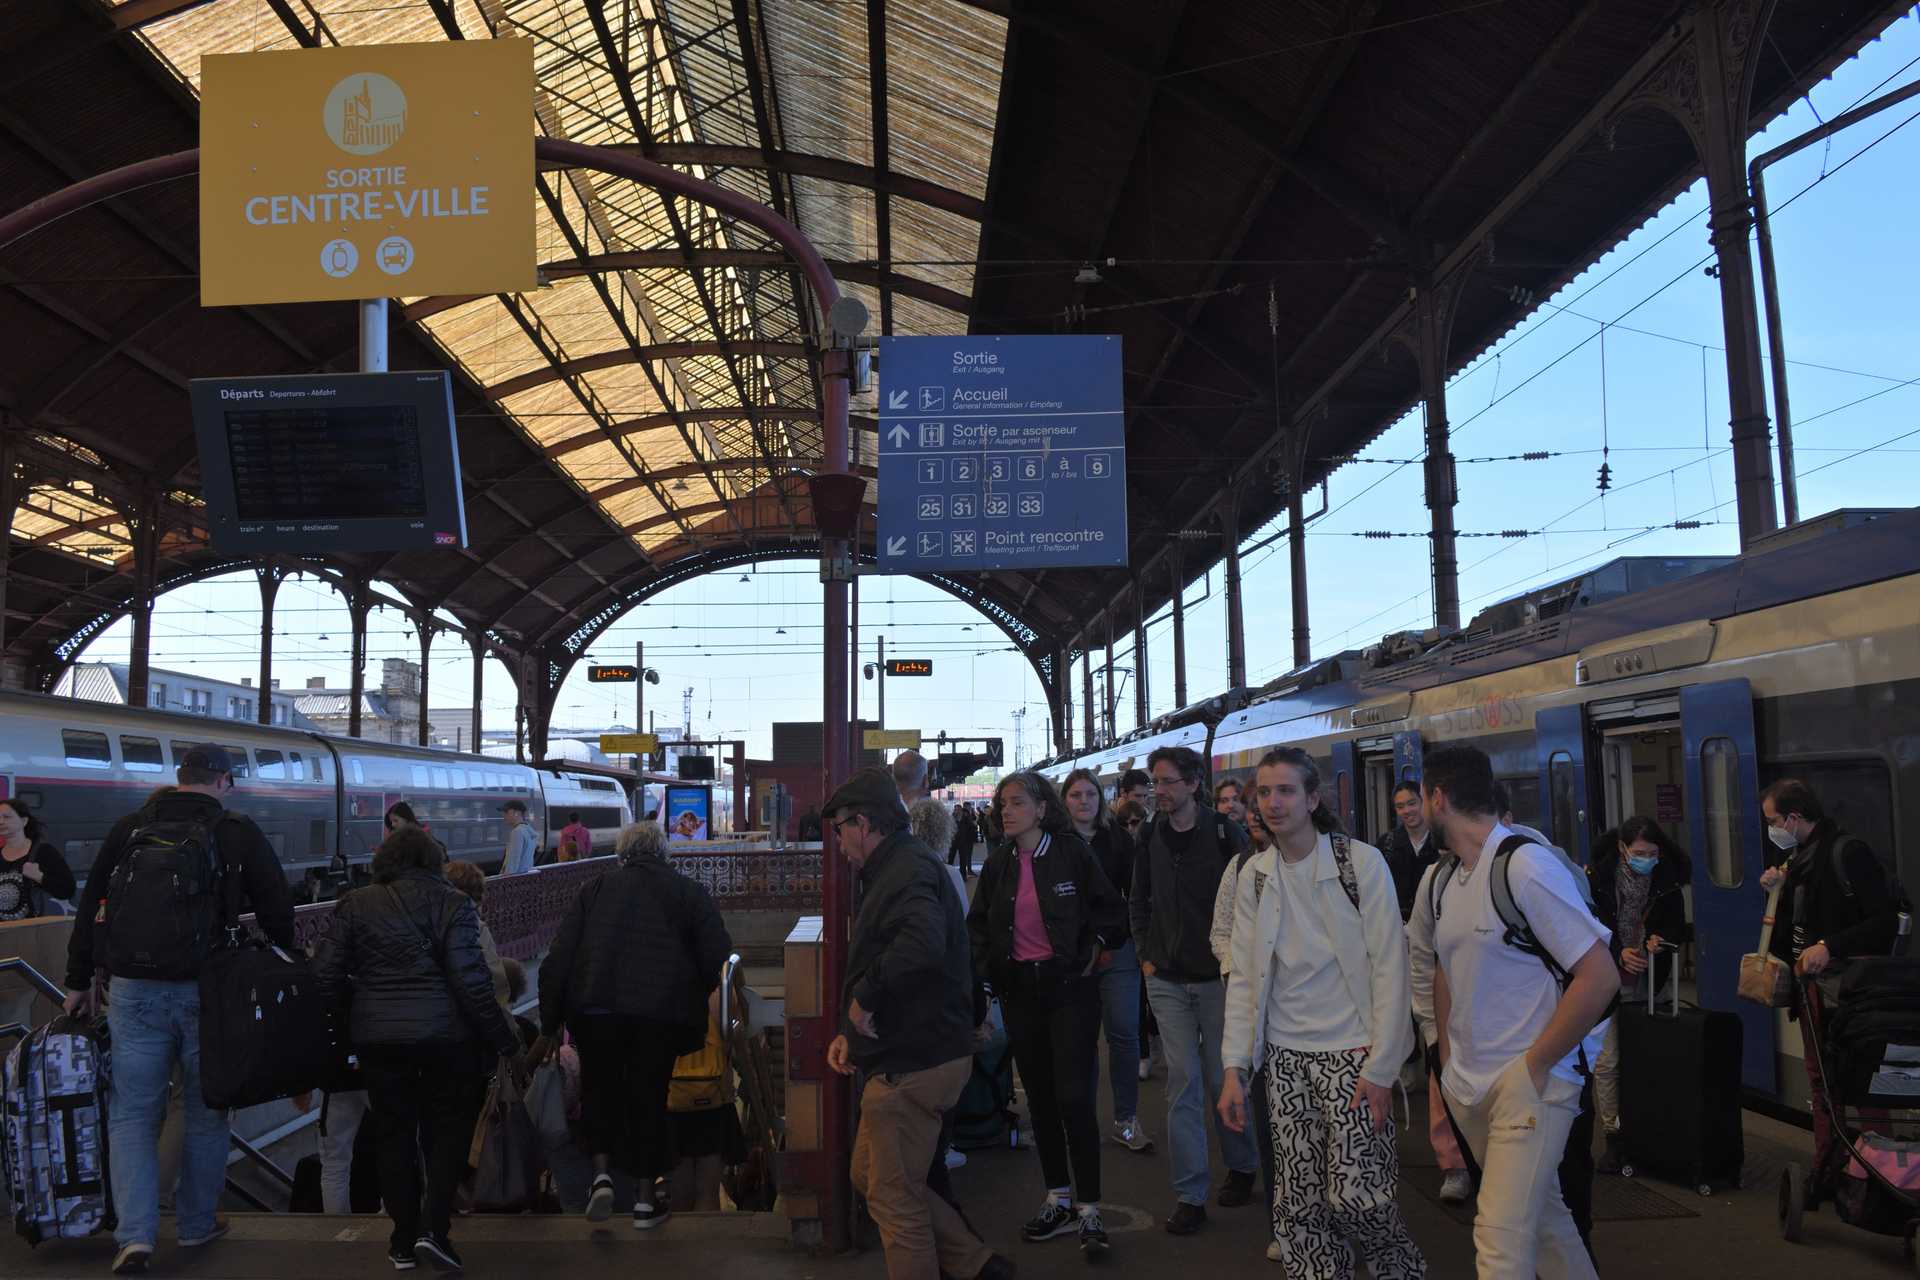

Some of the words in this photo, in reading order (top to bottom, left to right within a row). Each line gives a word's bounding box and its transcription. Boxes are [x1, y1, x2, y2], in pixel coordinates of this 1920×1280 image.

[326, 166, 406, 188] SORTIE
[245, 186, 489, 225] CENTRE-VILLE
[953, 351, 998, 365] Sortie
[953, 366, 966, 374] Exit
[974, 366, 1005, 375] Ausgang
[220, 388, 264, 401] Départs
[270, 390, 306, 399] Departures
[311, 388, 336, 396] Abfahrt
[952, 388, 1008, 401] Accueil
[952, 401, 981, 410] General
[1030, 400, 1063, 410] Empfang
[953, 424, 998, 438] Sortie
[1002, 427, 1021, 439] par
[1022, 425, 1078, 436] ascenseur
[952, 438, 966, 446] Exit
[967, 438, 977, 447] by
[994, 437, 1027, 447] Ausgang
[1028, 437, 1041, 445] mit
[927, 465, 936, 480] 1
[959, 464, 970, 479] 2
[992, 464, 1003, 479] 3
[1025, 463, 1036, 478] 6
[1059, 456, 1069, 471] à
[1092, 461, 1103, 476] 9
[921, 502, 941, 517] 25
[953, 501, 972, 516] 31
[987, 500, 1007, 515] 32
[1020, 499, 1040, 514] 33
[302, 523, 339, 532] destination
[985, 530, 1025, 545] Point
[1030, 528, 1105, 543] rencontre
[984, 545, 1014, 555] Meeting
[1016, 544, 1035, 554] point
